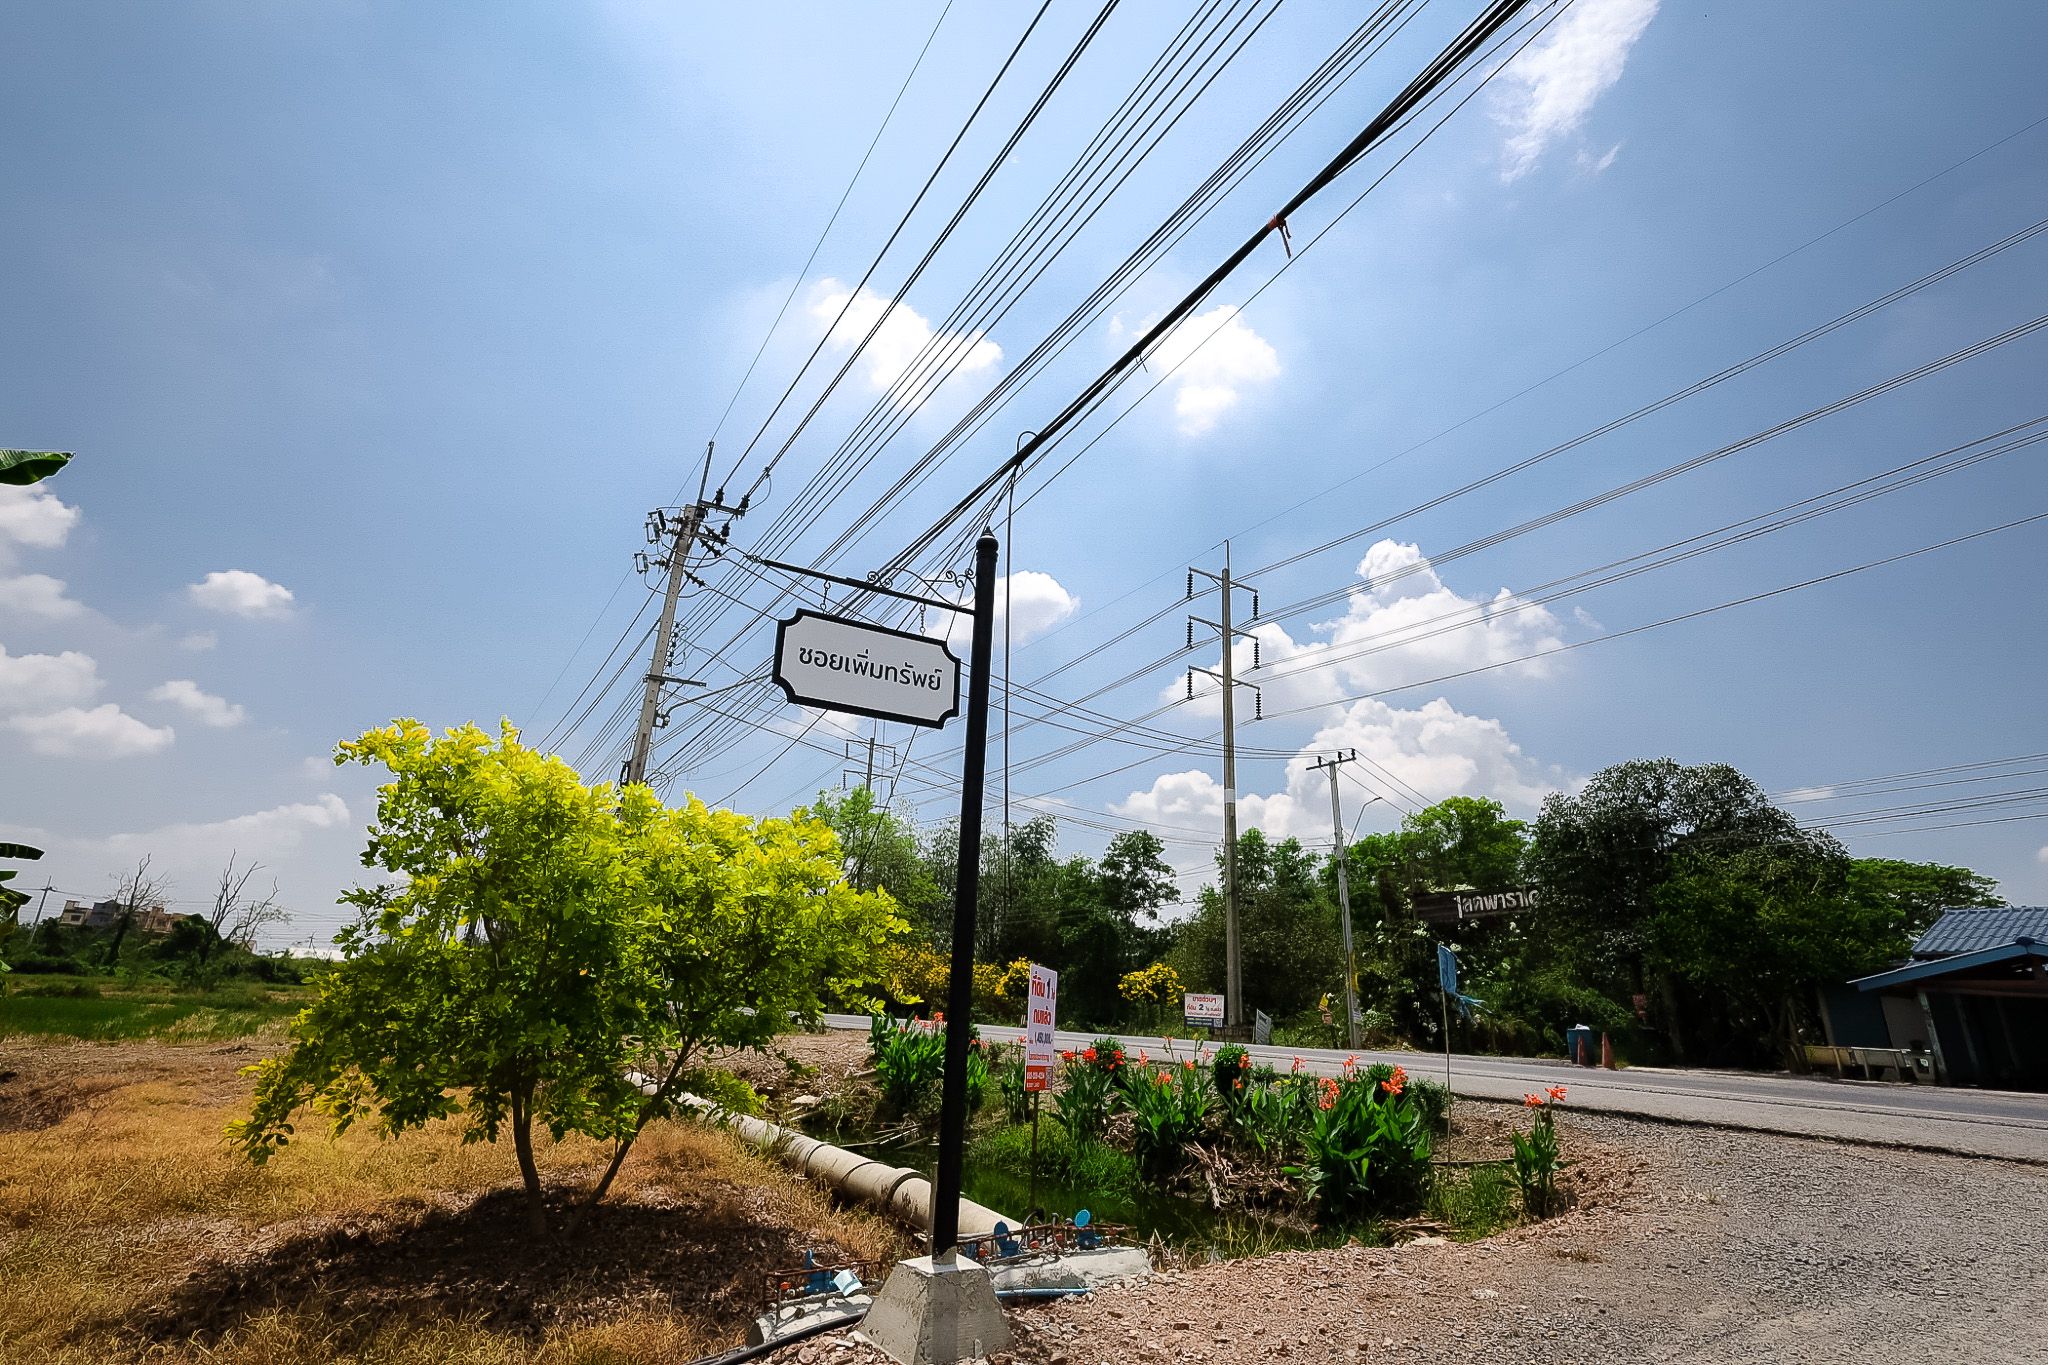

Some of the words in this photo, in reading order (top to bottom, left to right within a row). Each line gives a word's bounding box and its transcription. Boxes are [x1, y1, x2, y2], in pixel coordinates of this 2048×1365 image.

[799, 648, 942, 691] ซอยเพิ่มทรัพย์
[1046, 977, 1051, 999] 1
[1198, 1003, 1204, 1011] 2
